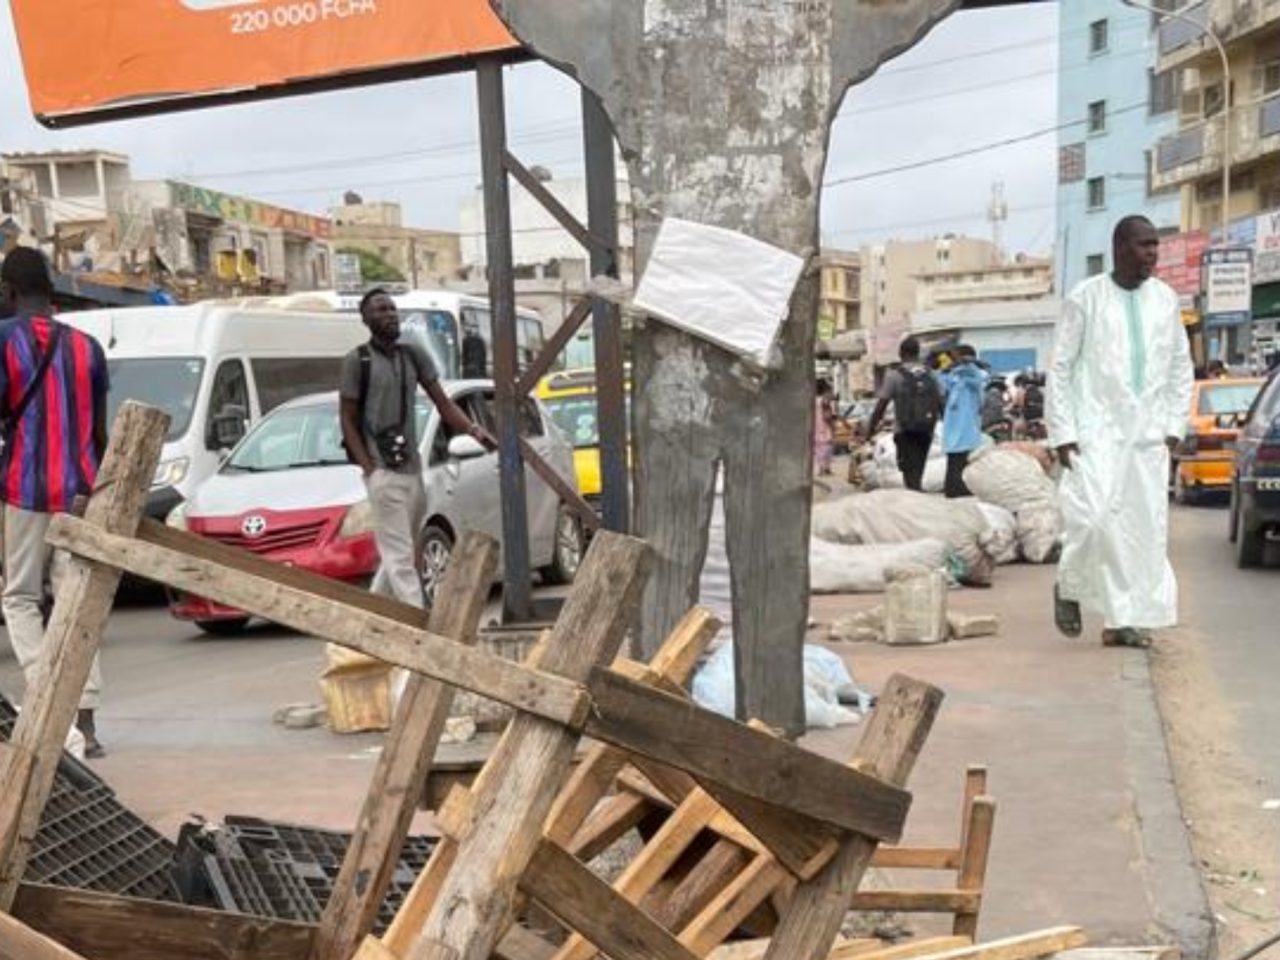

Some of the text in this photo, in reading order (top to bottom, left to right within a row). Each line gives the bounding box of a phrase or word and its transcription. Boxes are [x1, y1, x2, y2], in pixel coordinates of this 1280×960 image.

[230, 0, 376, 33] 220 000 FCFA
